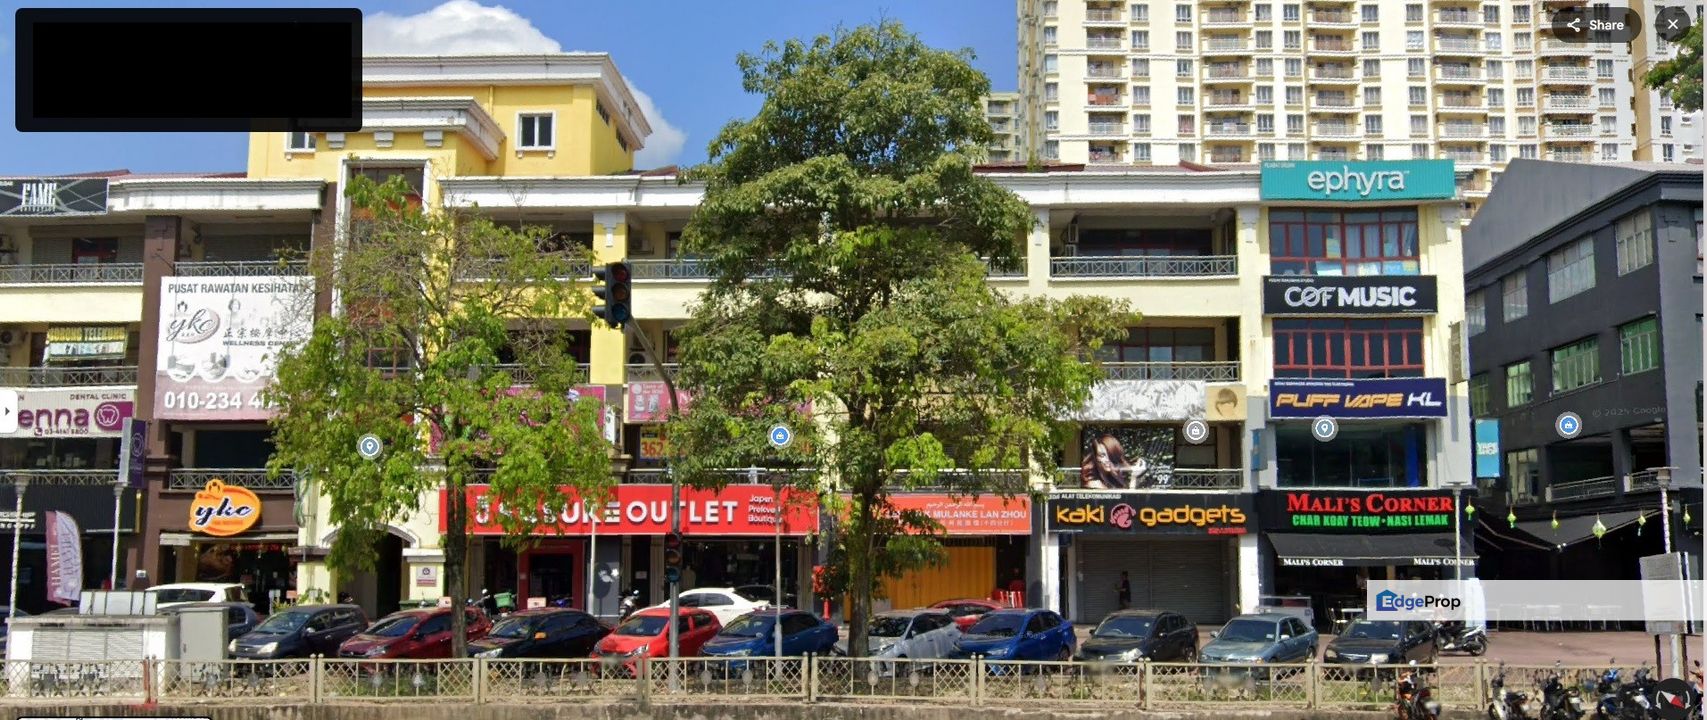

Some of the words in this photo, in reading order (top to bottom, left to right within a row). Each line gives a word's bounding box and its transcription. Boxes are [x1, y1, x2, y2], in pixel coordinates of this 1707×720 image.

[1307, 165, 1405, 195] ephyra
[168, 283, 198, 294] PUSAT
[200, 283, 249, 294] RAWATAN
[1337, 286, 1417, 307] MUSIC
[164, 391, 242, 409] 010-234
[1276, 393, 1341, 408] PUFF
[1344, 393, 1404, 408] VAPE
[1407, 391, 1442, 407] KL
[1287, 493, 1361, 512] MALI'S
[1365, 493, 1455, 512] CORNER
[934, 510, 978, 519] MULANKE
[981, 510, 998, 519] LAN
[1000, 510, 1027, 519] ZHOU
[1056, 504, 1105, 523] kaki
[1140, 504, 1247, 527] gadgets
[1292, 514, 1321, 526] CHAR
[1323, 515, 1349, 527] KOAY
[1351, 515, 1381, 527] TEOW
[1386, 515, 1412, 527] NASI
[1414, 514, 1449, 526] LEMAK
[1283, 558, 1311, 567] MALI'S
[1312, 558, 1344, 567] CORNER
[1413, 557, 1441, 566] MALI'S
[1443, 557, 1475, 567] CONER
